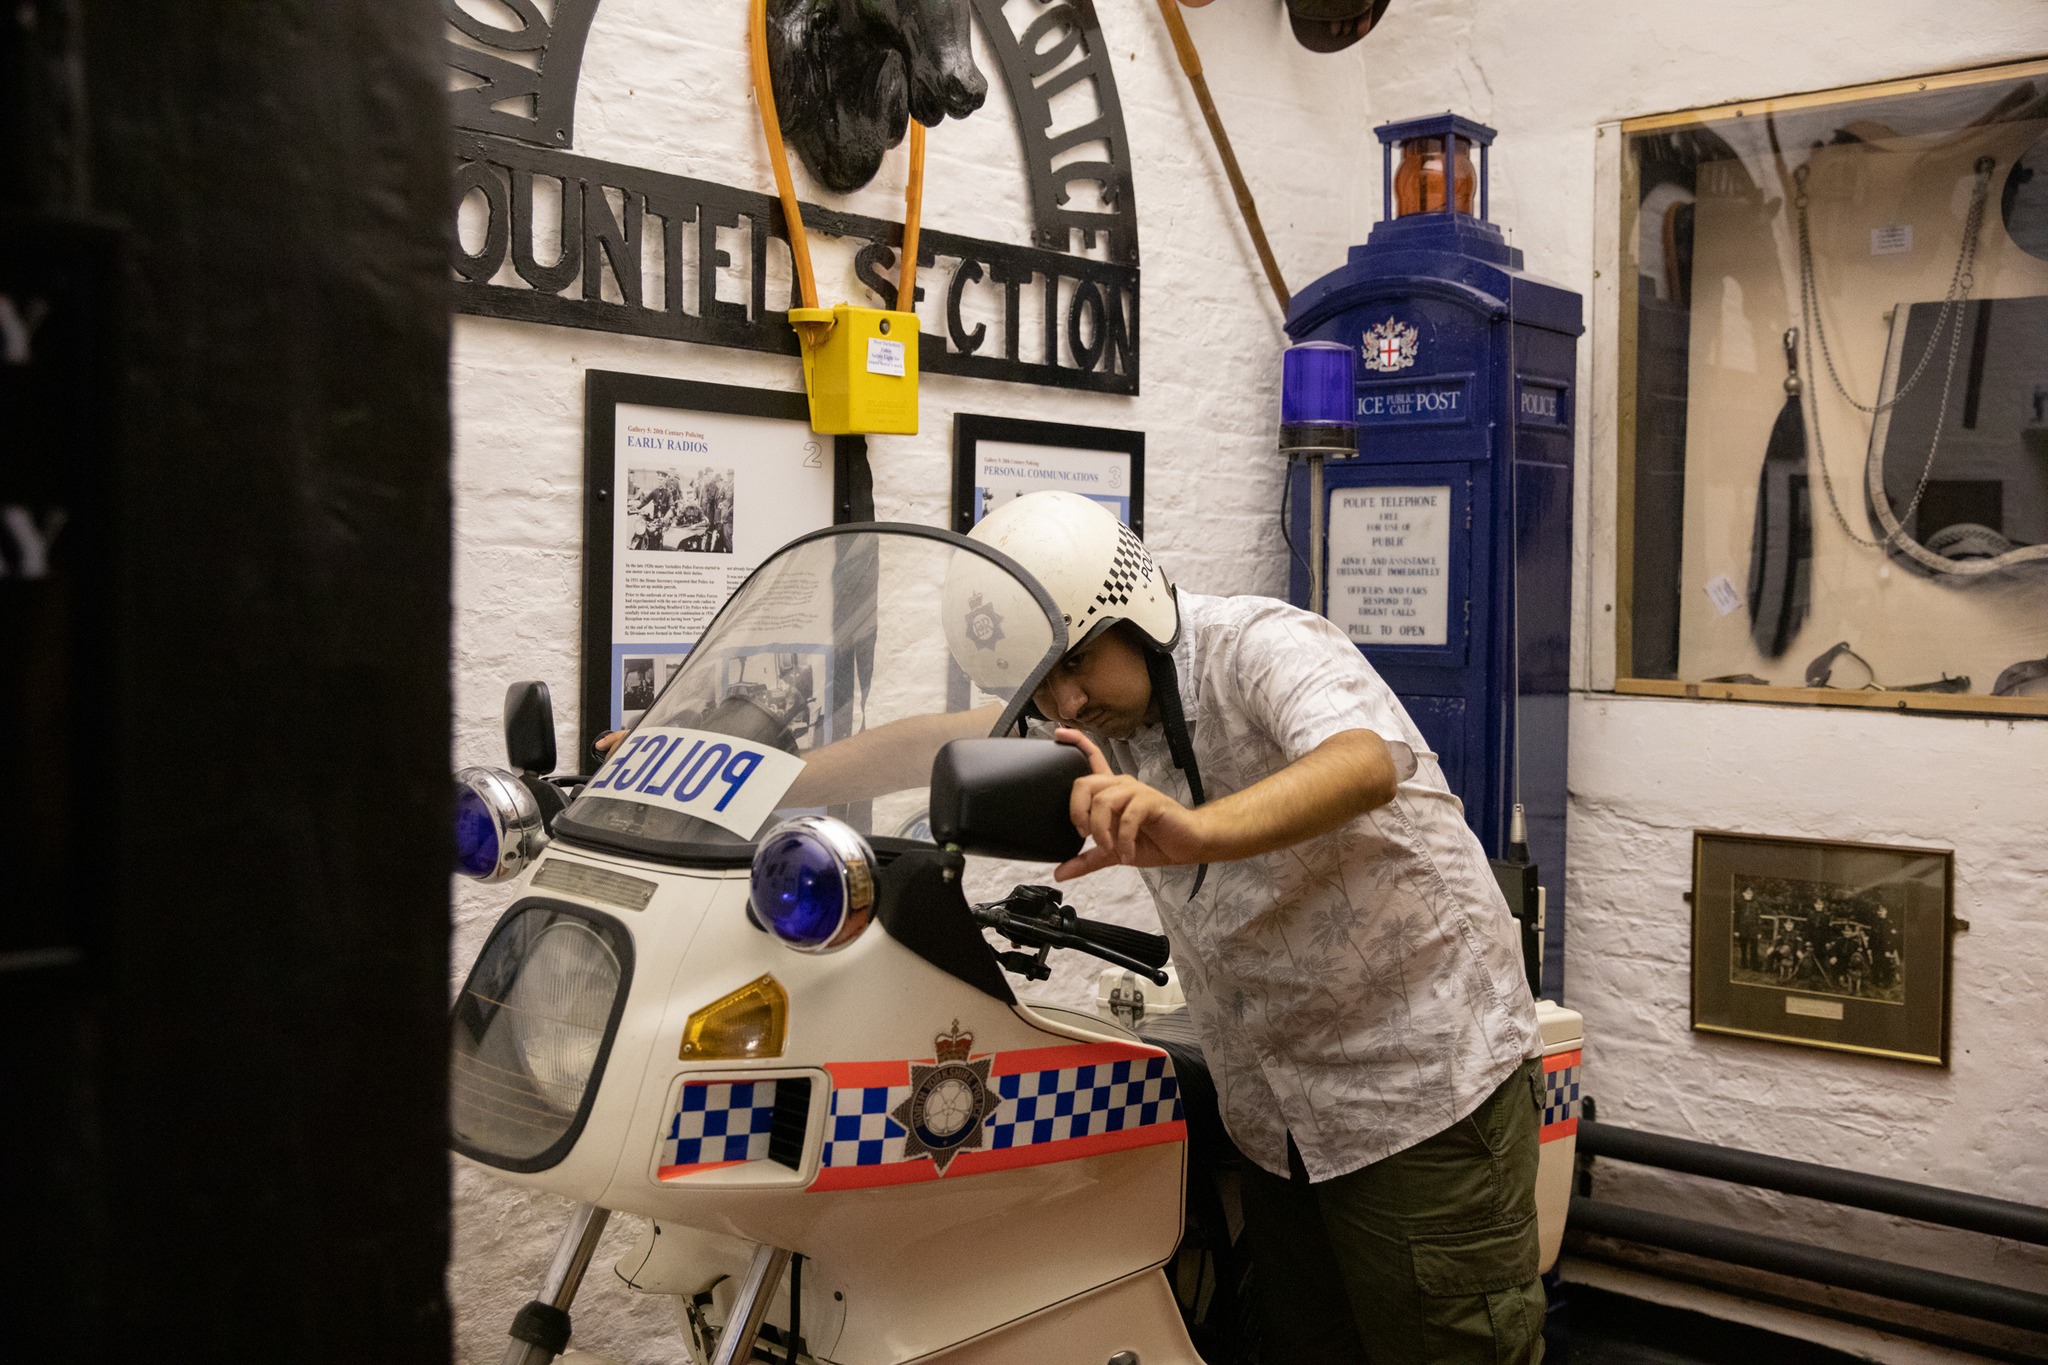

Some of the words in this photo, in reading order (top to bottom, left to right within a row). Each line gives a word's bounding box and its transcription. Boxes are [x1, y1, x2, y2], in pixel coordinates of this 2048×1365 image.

[1387, 394, 1415, 405] PUBLIC
[1416, 391, 1460, 412] POST
[1521, 393, 1556, 416] POLICE
[1389, 404, 1412, 415] CALL
[628, 426, 646, 434] Gallery
[664, 429, 684, 438] Century
[685, 431, 704, 440] Policing
[627, 436, 664, 450] EARLY
[667, 439, 708, 454] RADIOS
[803, 441, 822, 469] 2
[984, 465, 1026, 478] PERSONAL
[1028, 469, 1099, 483] COMMUNICATIONS
[1108, 466, 1121, 489] 3
[1343, 498, 1375, 508] POLICE
[1381, 496, 1437, 508] TELEPHONE
[1348, 625, 1372, 635] PULL
[1381, 625, 1392, 636] TO
[1399, 625, 1425, 636] OPEN
[923, 1067, 976, 1091] YORKSHIRE
